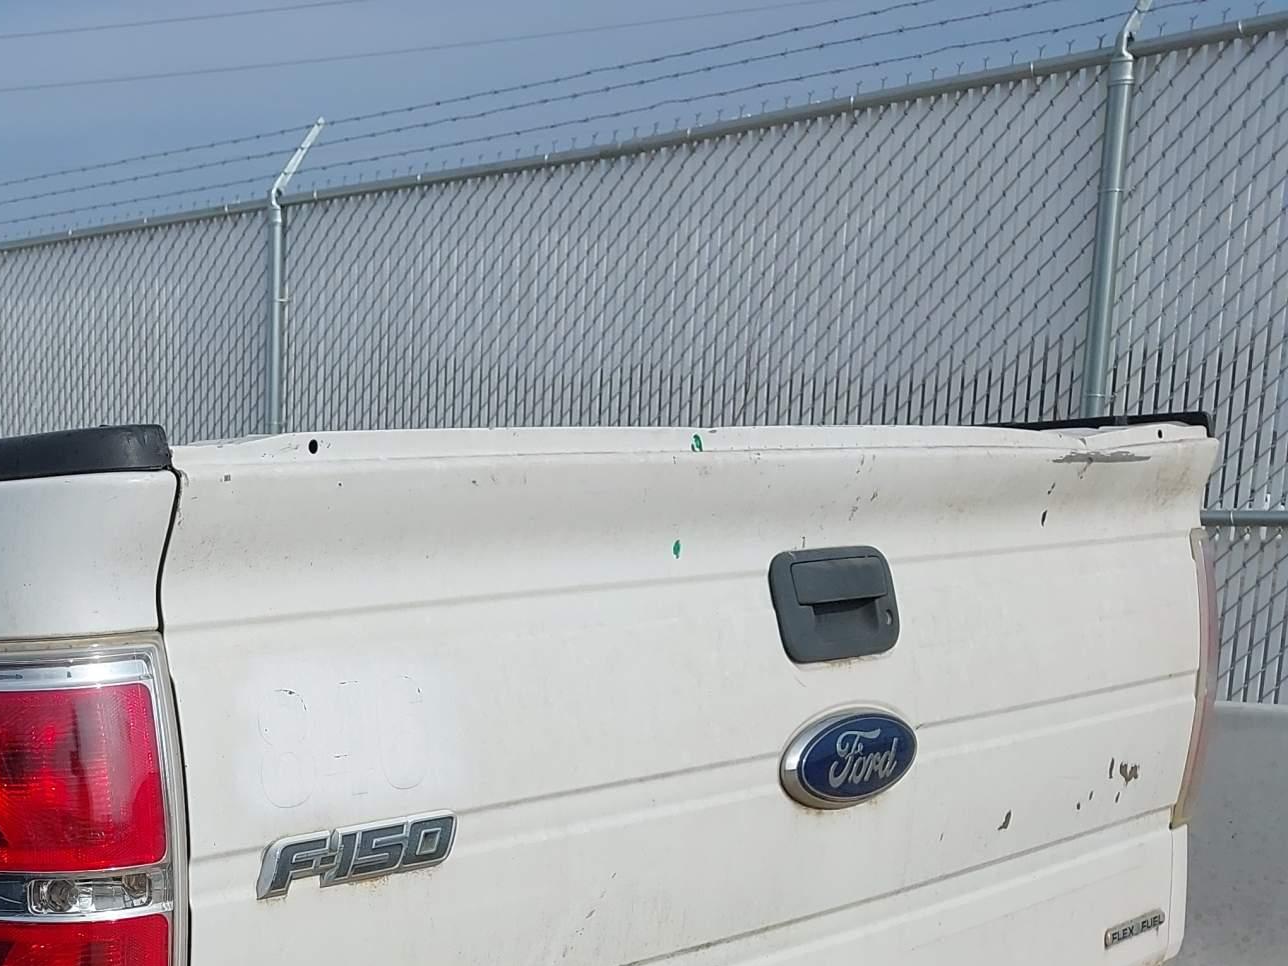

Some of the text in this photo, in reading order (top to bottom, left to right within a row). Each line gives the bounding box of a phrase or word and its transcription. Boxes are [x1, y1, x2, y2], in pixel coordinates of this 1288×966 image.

[828, 728, 899, 788] Ford
[256, 809, 458, 900] F-150
[1111, 913, 1165, 943] FLEX FUEL
